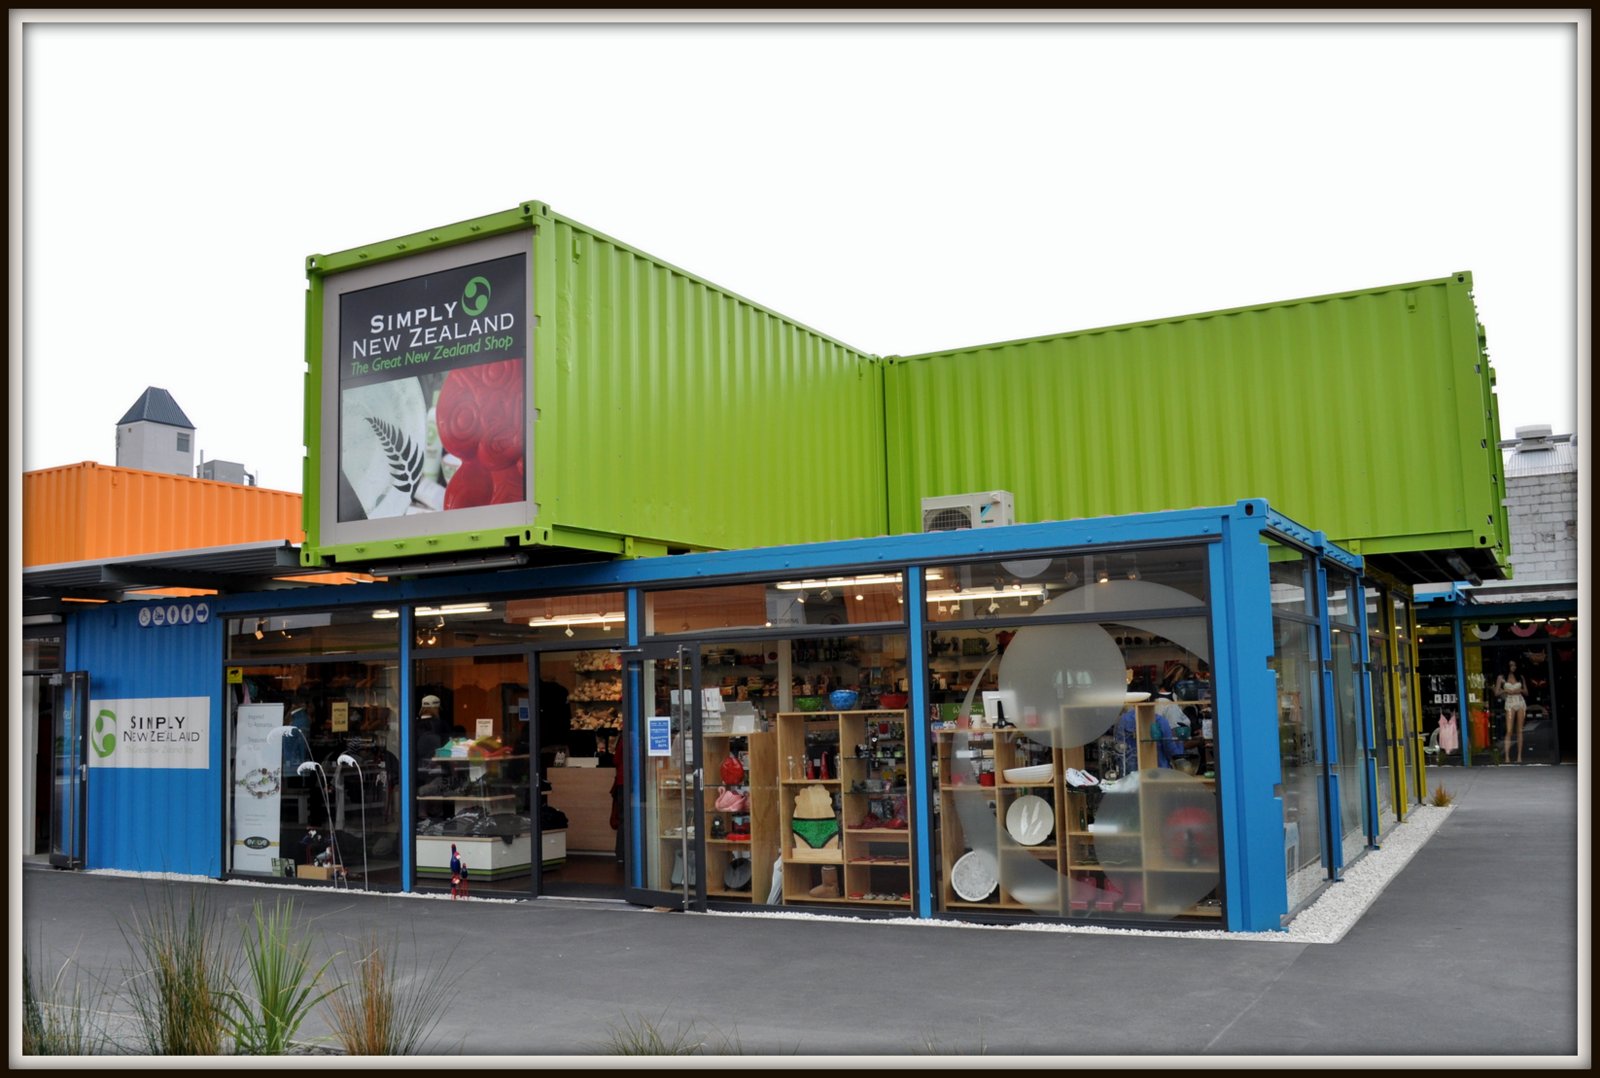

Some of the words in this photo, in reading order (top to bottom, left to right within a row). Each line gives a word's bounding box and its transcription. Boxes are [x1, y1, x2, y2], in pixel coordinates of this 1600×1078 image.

[352, 334, 401, 359] NEW
[409, 313, 514, 348] ZEALAND
[370, 301, 458, 334] SIMPLY
[351, 361, 369, 376] The
[372, 356, 402, 372] Great
[404, 351, 431, 366] New
[433, 338, 481, 361] Zealand
[484, 335, 513, 351] Shop
[123, 730, 148, 742] NEW
